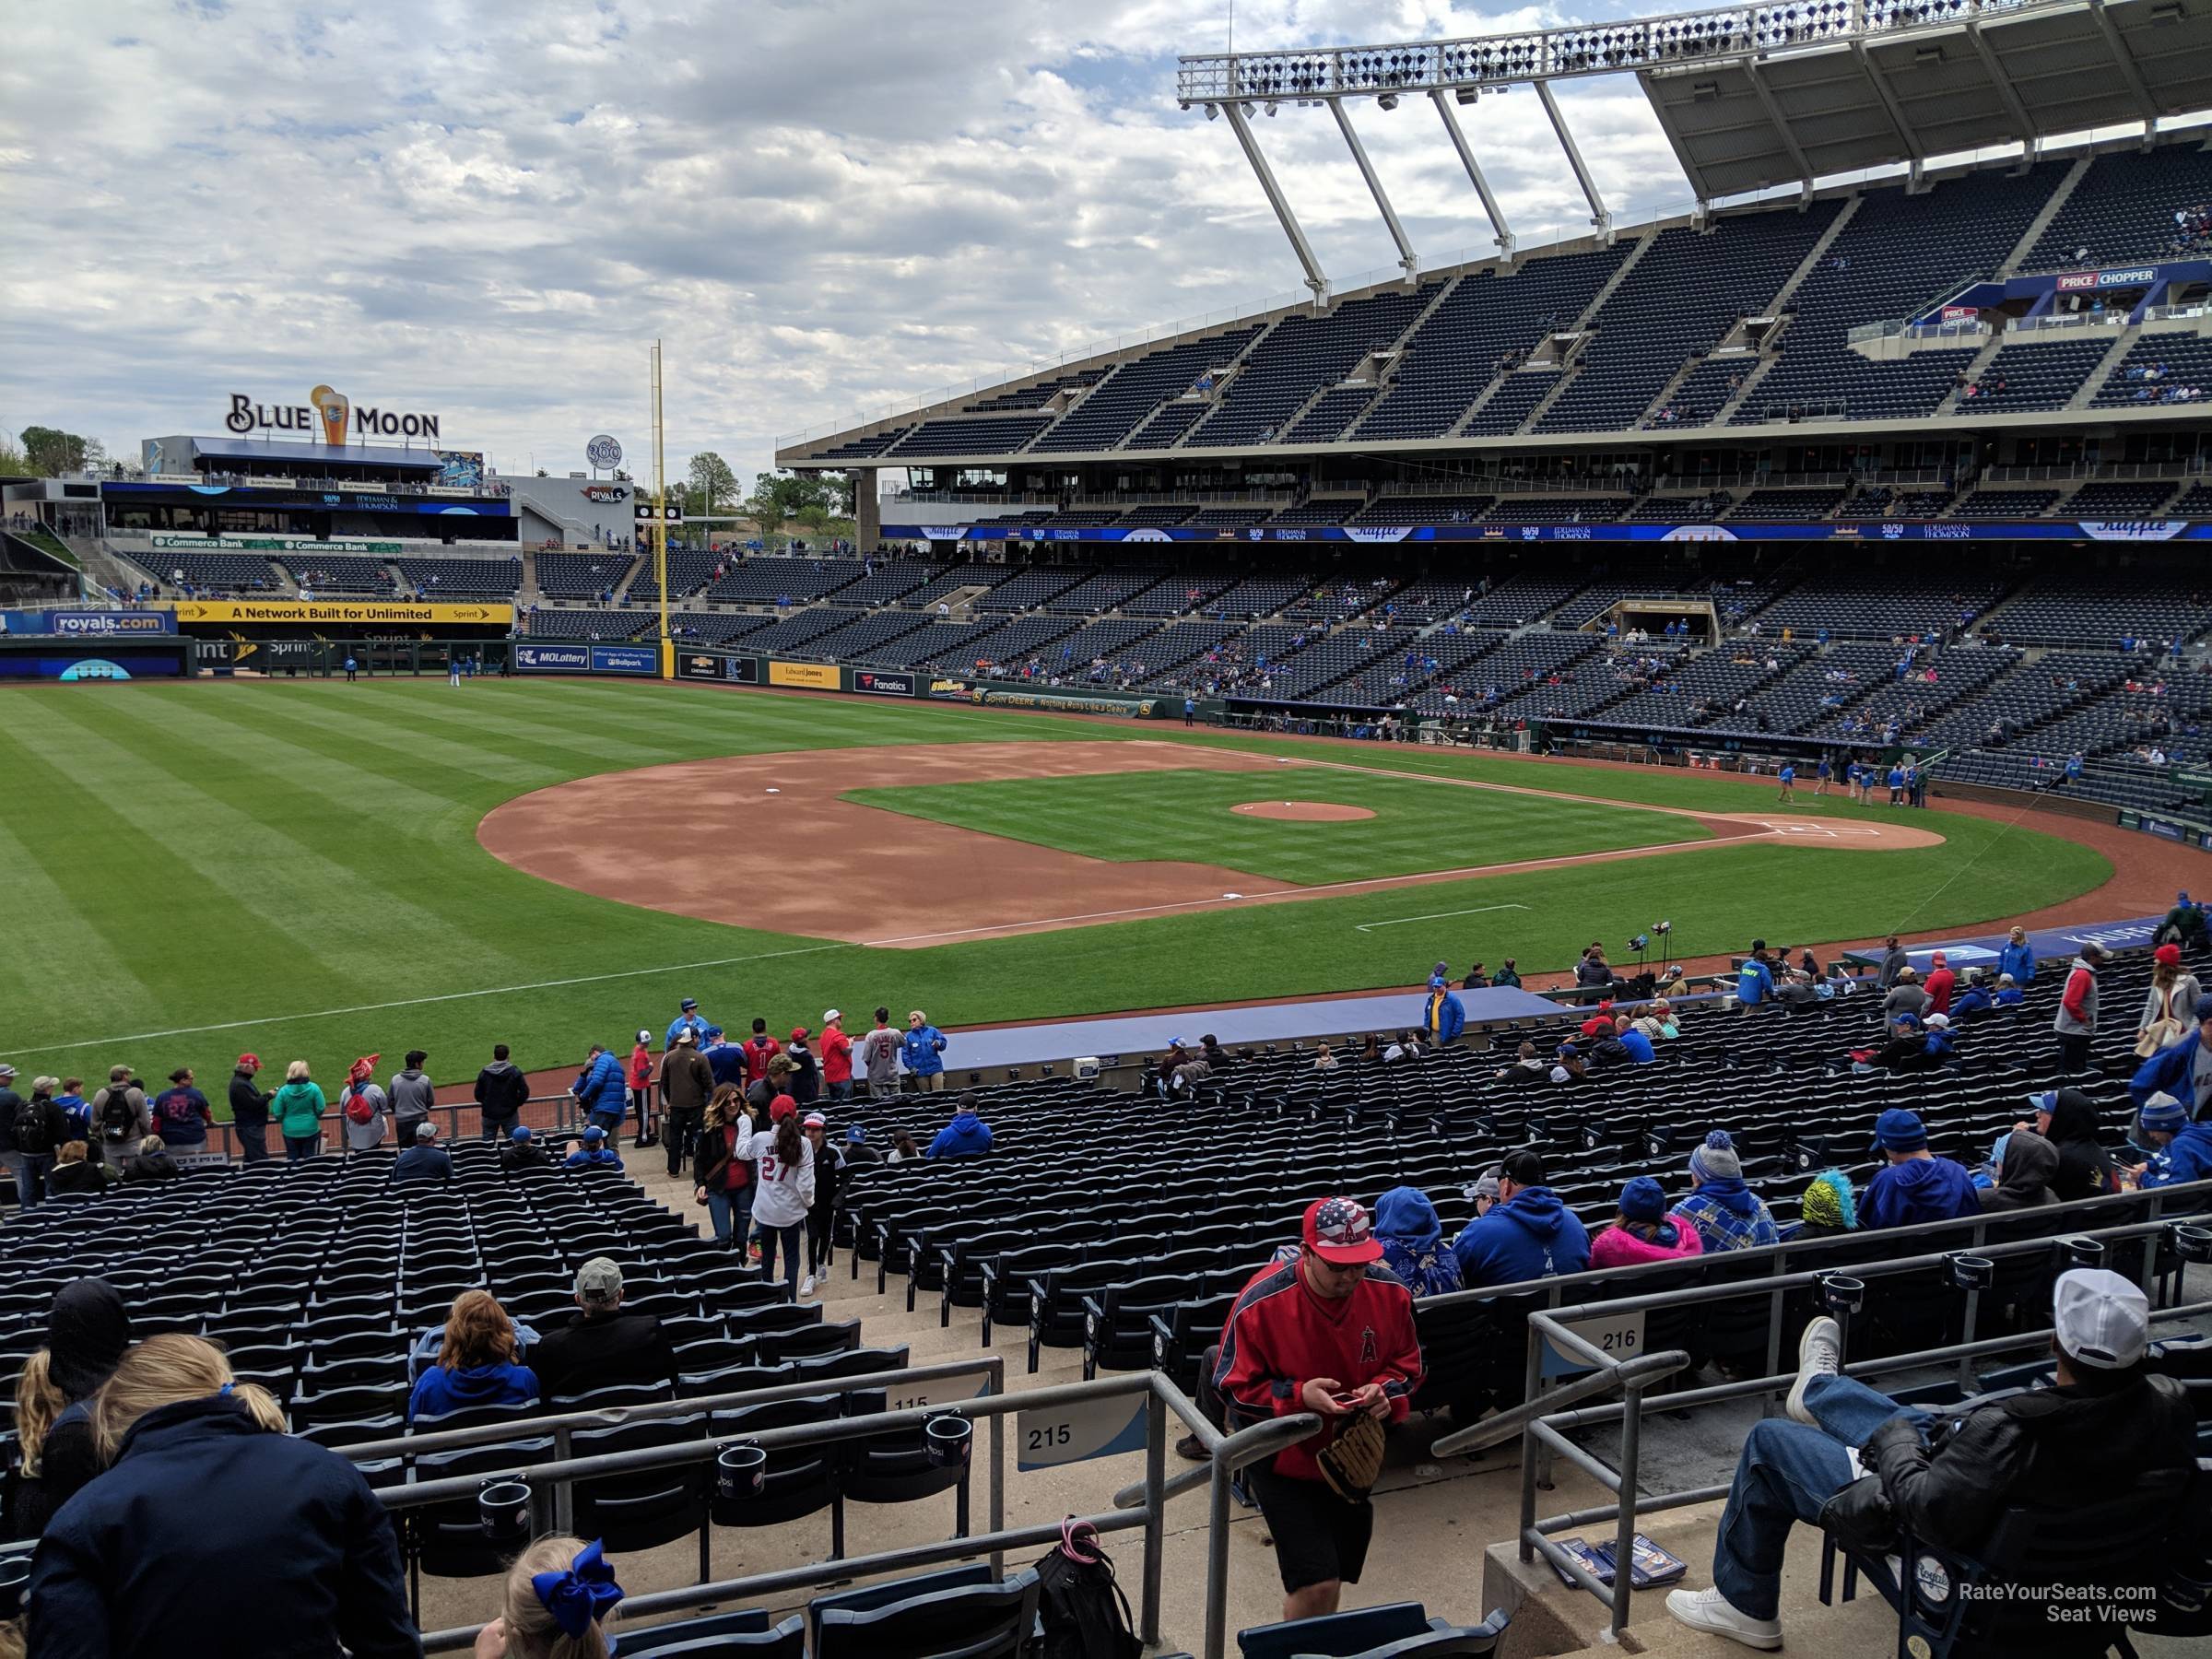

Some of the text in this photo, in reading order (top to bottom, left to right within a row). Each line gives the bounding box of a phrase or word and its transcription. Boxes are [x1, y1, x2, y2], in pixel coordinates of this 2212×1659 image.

[2061, 270, 2154, 288] PRICE CHOPPER
[1944, 309, 1965, 319] PRICE
[226, 392, 441, 438] BLUE MOON
[589, 441, 622, 463] 360
[591, 491, 622, 501] RIVALS
[1249, 528, 1264, 536] 50/50
[1522, 526, 1539, 536] 50/50
[1583, 525, 1591, 534] &
[1881, 524, 1904, 534] 50/50
[167, 537, 244, 548] Commerce Bank
[296, 540, 369, 551] Commerce Bank
[232, 607, 432, 619] A Network Built for Unlimited
[453, 610, 478, 619] Sprint
[59, 616, 159, 632] royals.com
[539, 653, 587, 665] MOLottery
[615, 658, 642, 667] Ballpark
[785, 665, 823, 677] Edward Jones
[874, 678, 907, 691] Fanatics
[985, 694, 1006, 704] JOHN
[1008, 695, 1035, 706] DEERE
[1040, 699, 1066, 710] Nothing
[1067, 700, 1084, 710] Runs
[1106, 704, 1128, 713] Deere
[1742, 968, 1759, 977] STAFF
[879, 1044, 889, 1059] 5
[759, 1052, 767, 1070] 1
[762, 1156, 790, 1182] 27
[1343, 1218, 1358, 1241] A
[1545, 1255, 1554, 1272] 4
[1359, 1325, 1379, 1364] A
[1603, 1329, 1636, 1351] 216
[1028, 1424, 1071, 1451] 215
